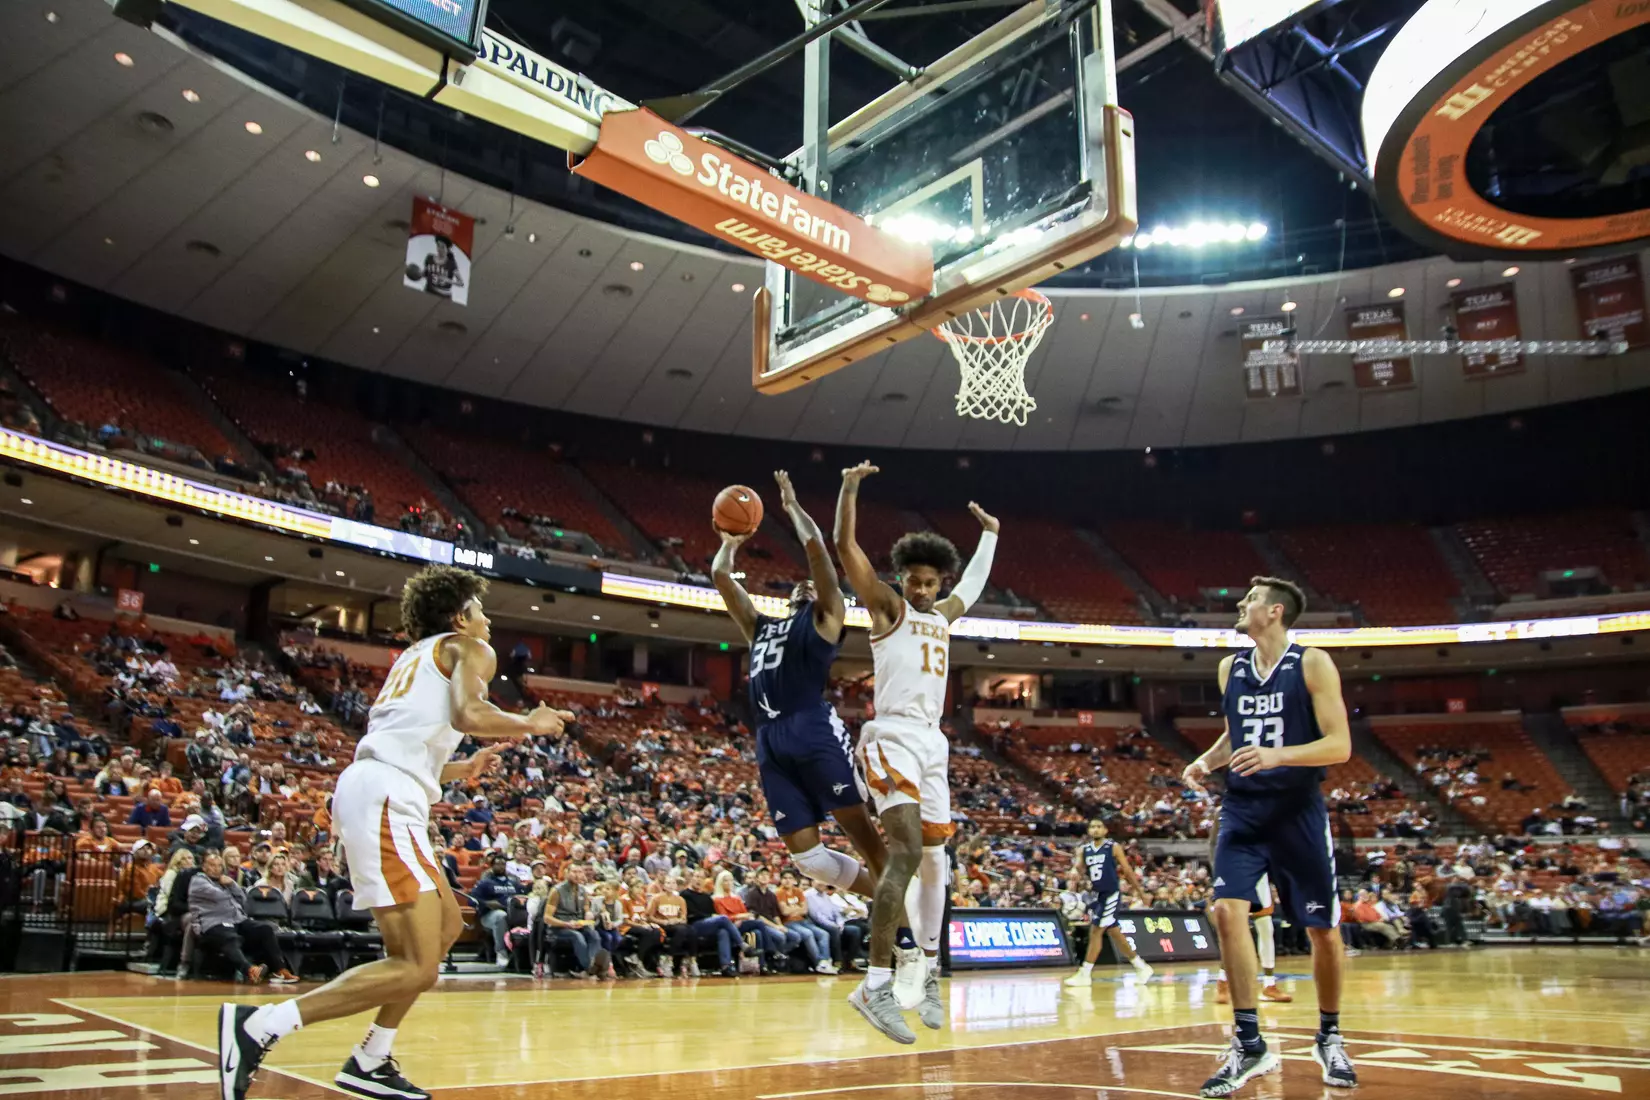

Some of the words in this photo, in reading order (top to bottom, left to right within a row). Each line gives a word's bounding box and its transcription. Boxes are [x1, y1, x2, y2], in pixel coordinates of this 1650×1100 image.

[1358, 308, 1394, 320] TEXAS
[1249, 321, 1284, 332] TEXAS
[909, 620, 949, 643] TEXA
[750, 635, 788, 678] 35
[920, 642, 946, 678] 13
[1237, 692, 1284, 715] CBU
[1242, 717, 1285, 749] 33
[964, 922, 1013, 946] EMPIRE
[1009, 922, 1060, 945] CLASSIC
